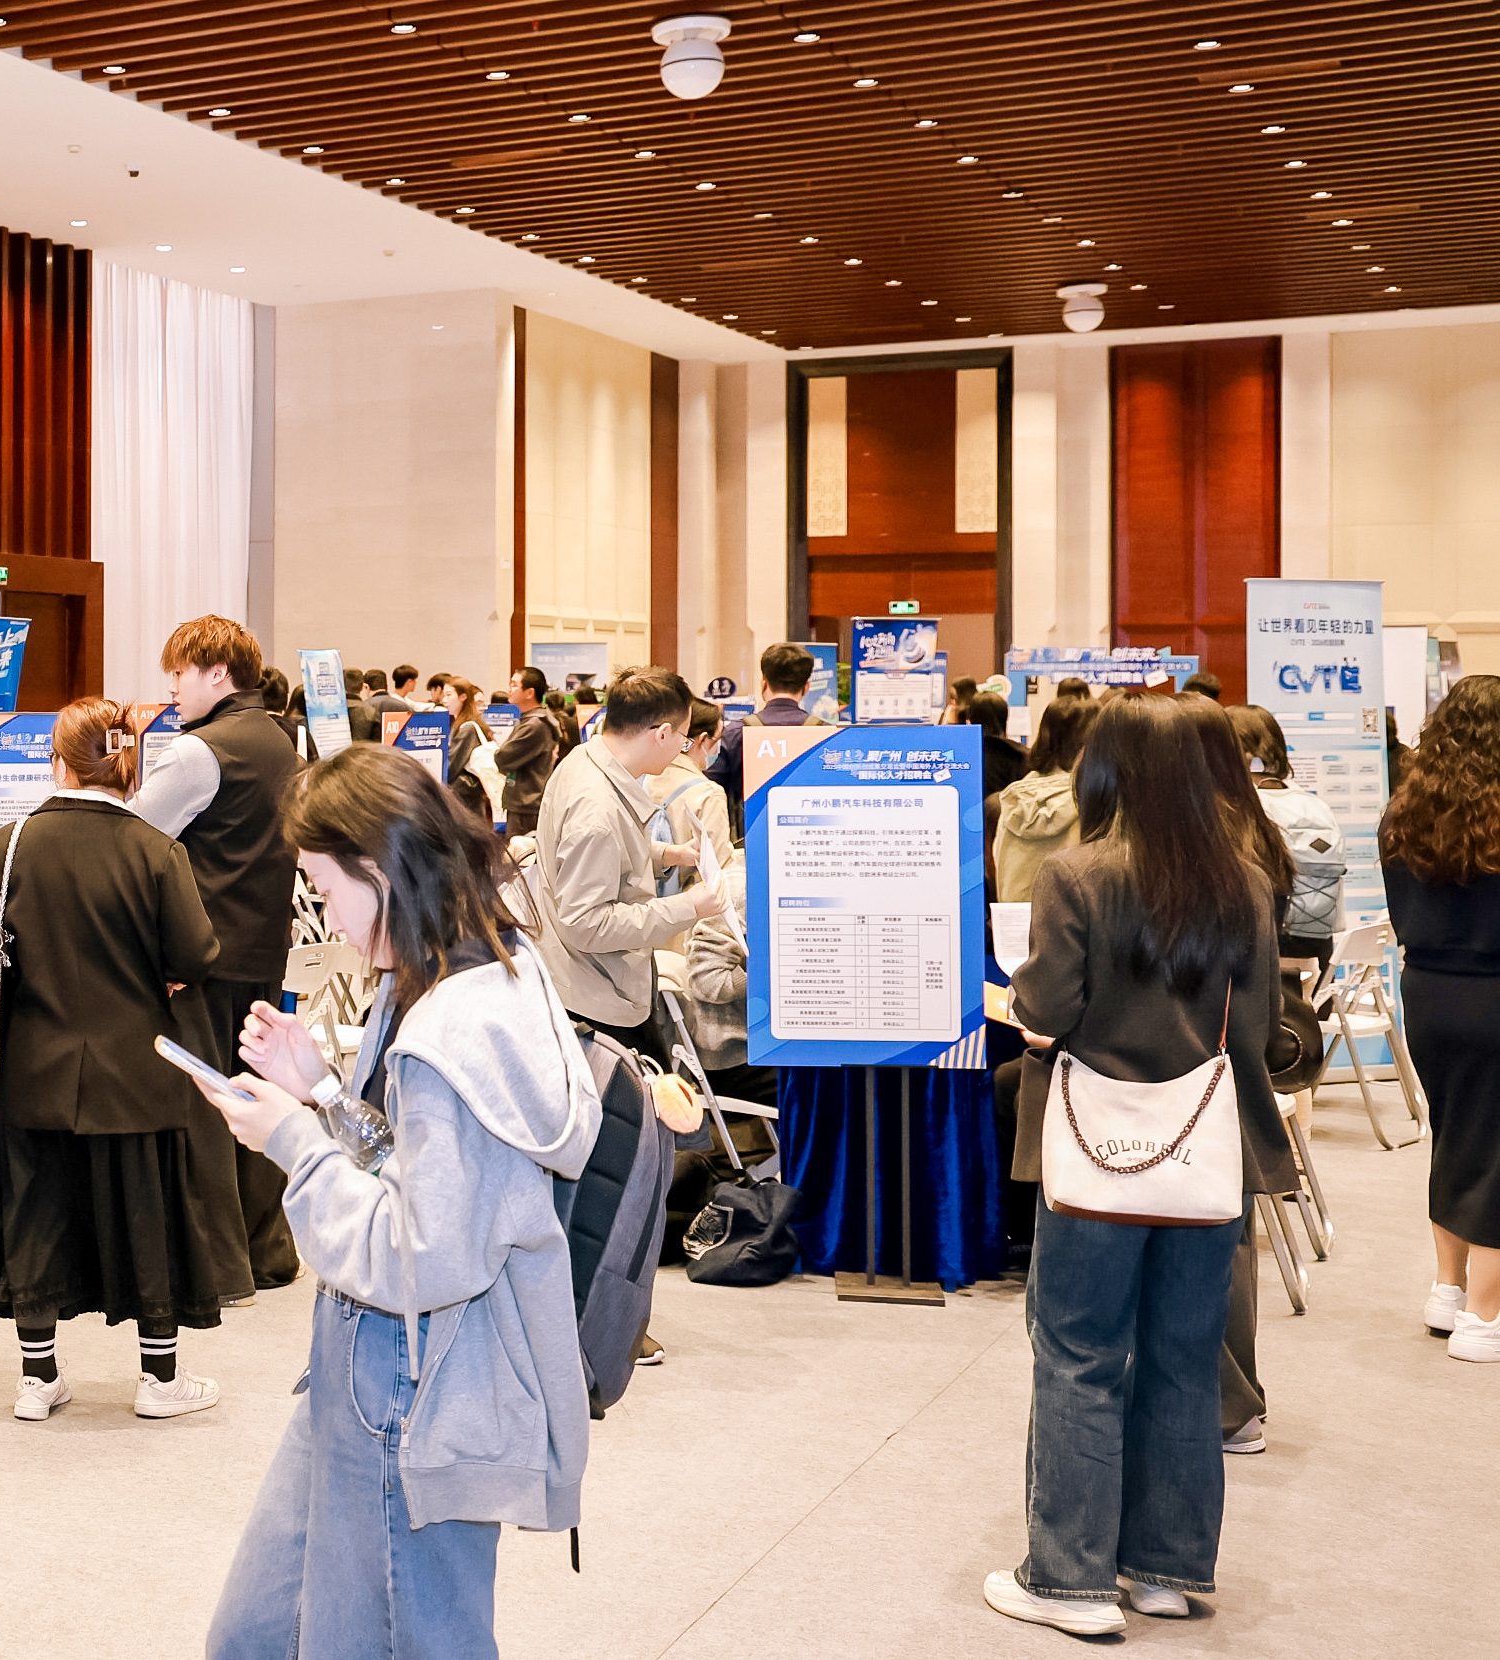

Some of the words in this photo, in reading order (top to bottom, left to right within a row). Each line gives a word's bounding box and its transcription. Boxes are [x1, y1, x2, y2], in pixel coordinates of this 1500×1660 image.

[1259, 618, 1374, 634] 让世界看见年轻的力量
[1278, 663, 1362, 694] CVTE
[140, 710, 155, 720] A19
[386, 721, 399, 734] A10
[757, 740, 787, 757] A1
[864, 750, 902, 762] 聚广州
[906, 750, 946, 762] 创未来
[858, 770, 933, 780] 国际化人才招聘会
[801, 798, 924, 808] 广州小鹏汽车科技有限公司
[779, 816, 809, 824] 公司简介
